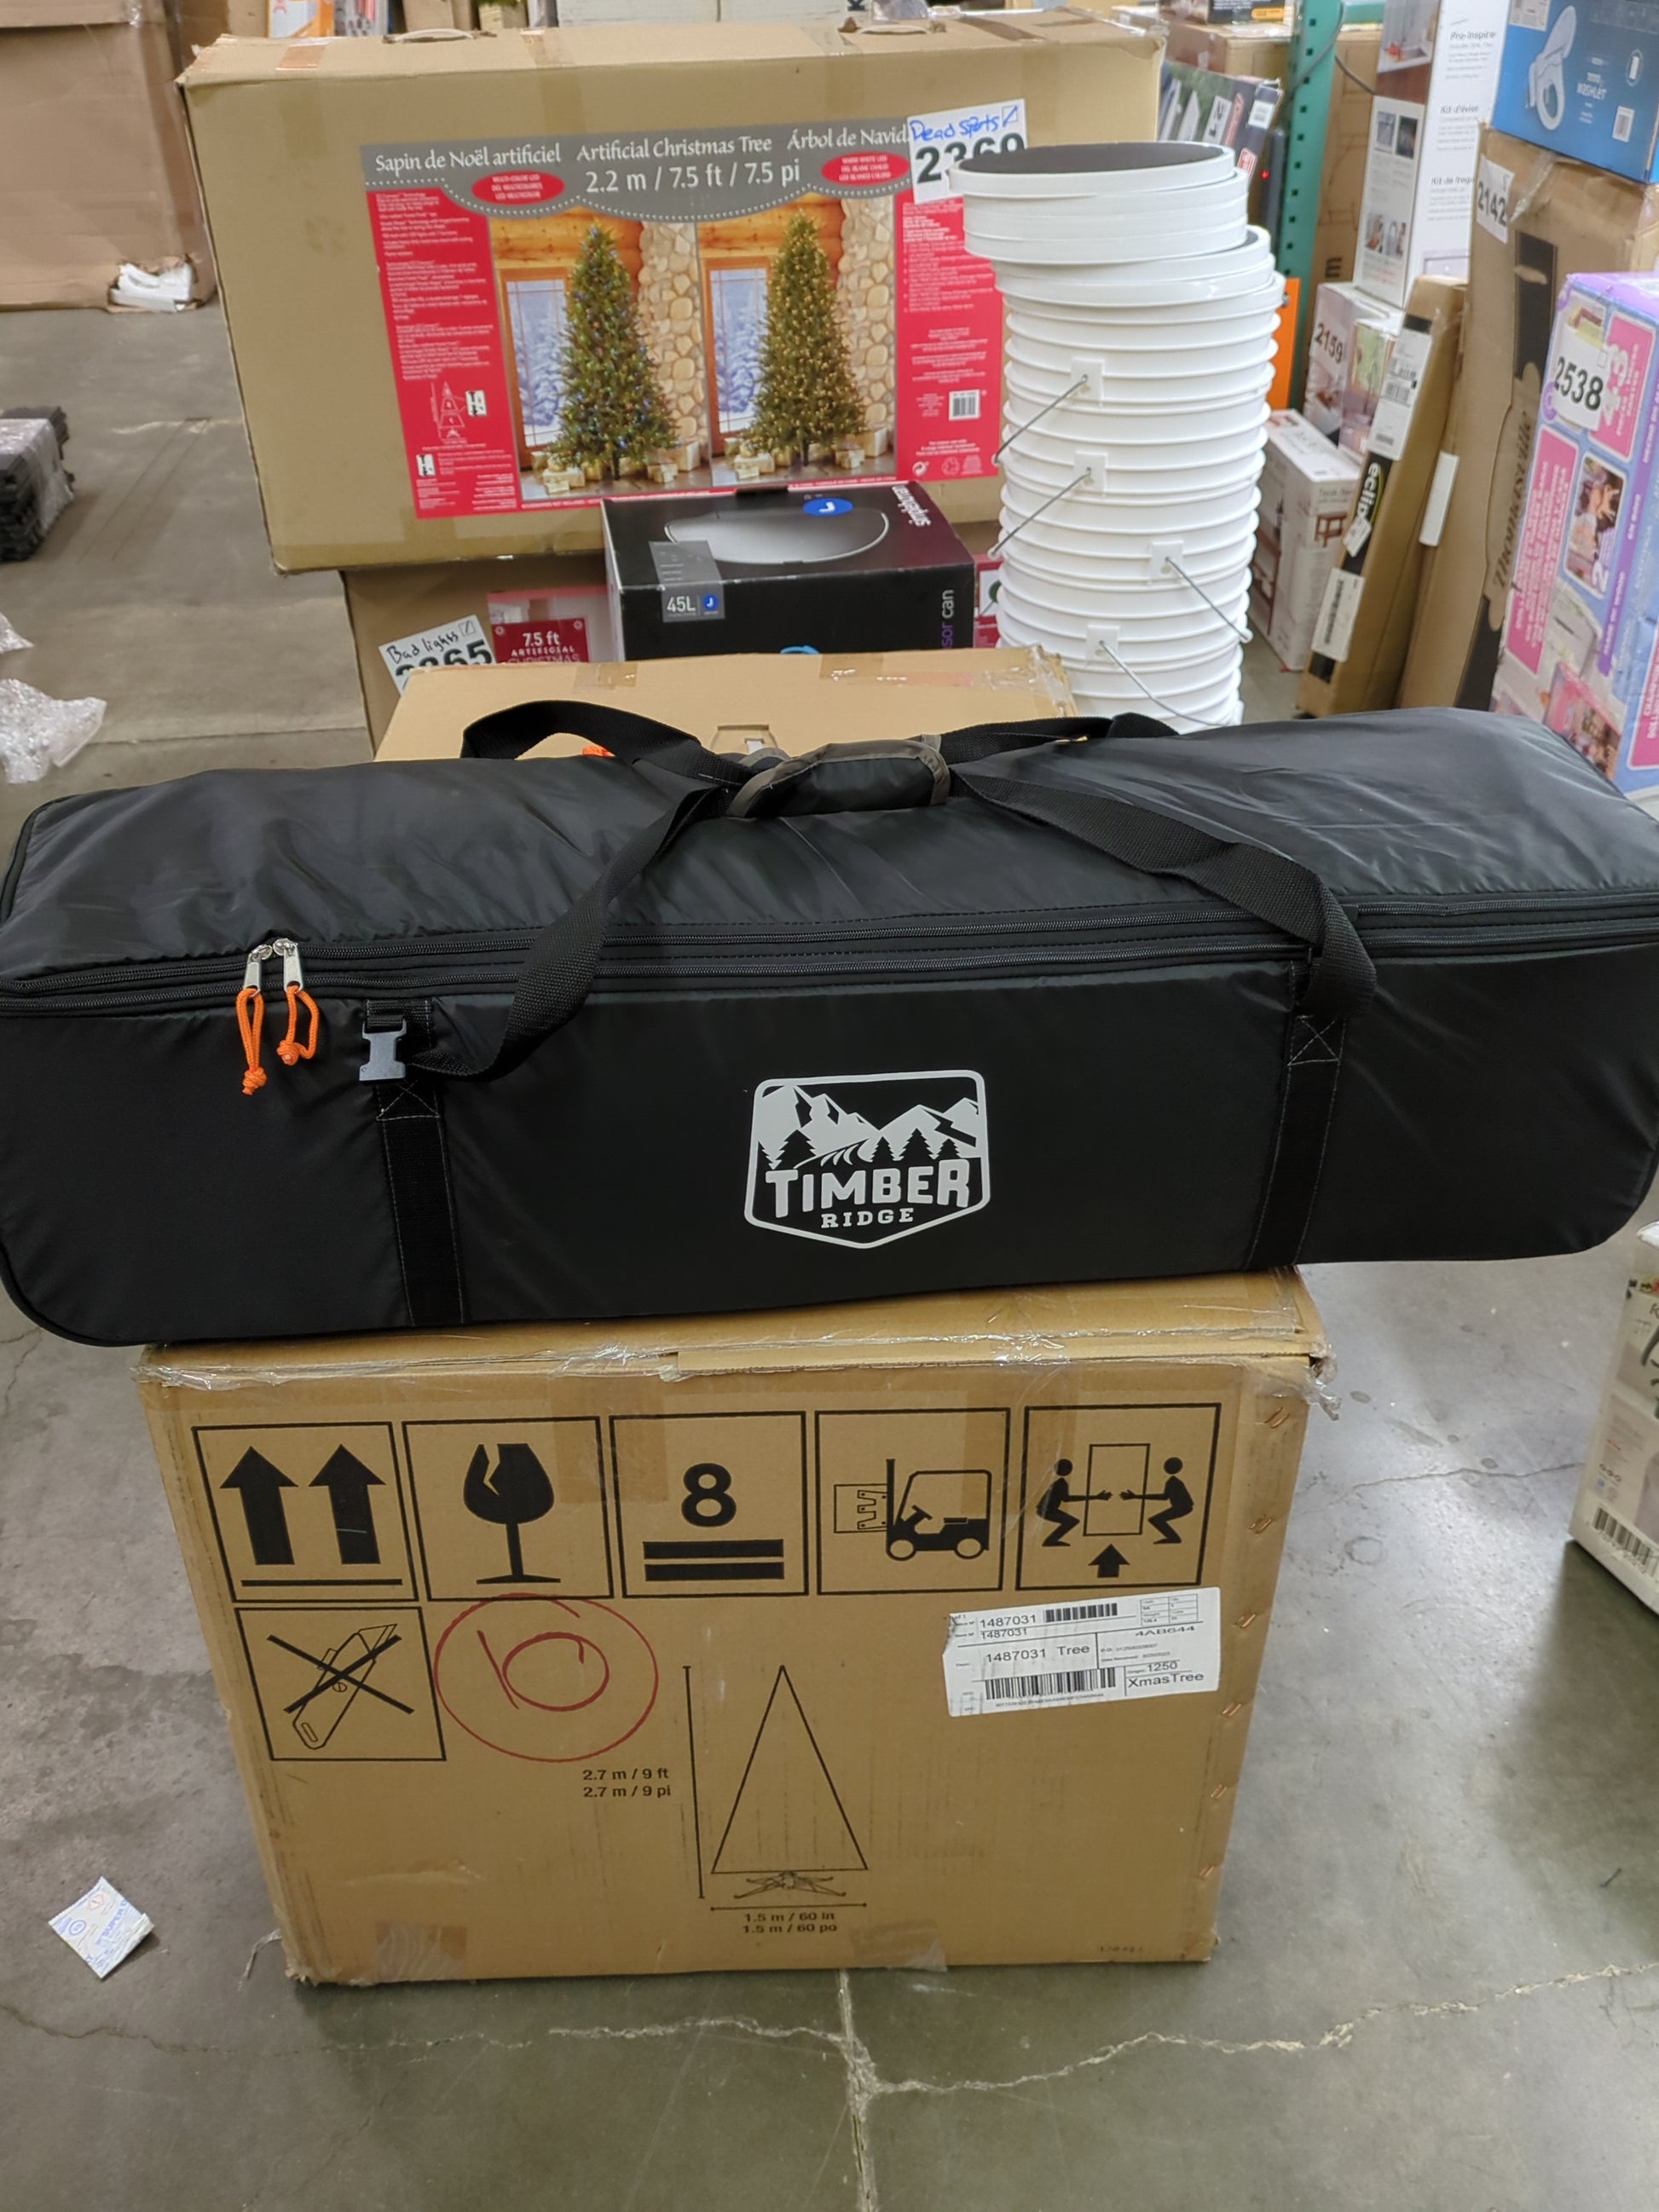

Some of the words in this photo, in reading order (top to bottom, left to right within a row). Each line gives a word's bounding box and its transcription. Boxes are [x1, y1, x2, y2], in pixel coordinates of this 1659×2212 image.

[787, 127, 834, 150] Árbol
[836, 127, 858, 147] de
[859, 124, 910, 146] Navid
[909, 119, 956, 141] Dead
[375, 153, 421, 177] Sapin
[424, 149, 447, 170] de
[448, 146, 490, 169] Noël
[492, 142, 562, 167] artificiel
[576, 137, 650, 162] Artificial
[652, 137, 735, 158] Christmas
[738, 136, 772, 153] Tree
[585, 170, 620, 193] 2.2
[627, 171, 647, 192] m
[654, 166, 662, 192] /
[668, 165, 699, 189] 7.5
[705, 162, 723, 188] ft
[729, 162, 738, 188] /
[744, 161, 774, 185] 7.5
[781, 158, 801, 187] pi
[1477, 181, 1507, 228] 2142
[1314, 321, 1344, 364] 2159
[1554, 355, 1604, 412] 2538
[1357, 461, 1382, 517] eclip
[667, 595, 697, 613] 45L
[940, 589, 955, 619] can
[522, 632, 544, 647] 7.5
[546, 630, 560, 645] ft
[940, 621, 955, 648] sor
[386, 644, 421, 665] Bad
[512, 645, 575, 657] ARTIFICIAL
[766, 1158, 970, 1219] TIMBER
[820, 1208, 915, 1228] RIDGE
[681, 1463, 737, 1528] 8
[980, 1614, 1037, 1628] 1487031
[980, 1628, 1028, 1639] 1487031
[985, 1649, 1047, 1663] 1487031
[1057, 1643, 1090, 1656] Tree
[1147, 1660, 1178, 1672] 1250
[1128, 1671, 1205, 1689] XmasTree
[582, 1770, 607, 1781] 2.7
[612, 1770, 627, 1780] m
[631, 1768, 638, 1780] /
[642, 1768, 652, 1780] 9
[657, 1767, 668, 1779] ft
[583, 1786, 607, 1798] 2.7
[612, 1788, 627, 1798] m
[631, 1785, 638, 1797] /
[642, 1786, 653, 1797] 9
[657, 1784, 671, 1799] pi
[745, 1913, 766, 1922] 1.5
[770, 1914, 784, 1922] m
[788, 1912, 795, 1921] /
[798, 1912, 818, 1921] 60
[821, 1911, 835, 1920] in
[743, 1924, 765, 1934] 1.5
[769, 1925, 783, 1933] m
[786, 1923, 793, 1933] /
[796, 1923, 815, 1932] 60
[819, 1923, 838, 1934] po
